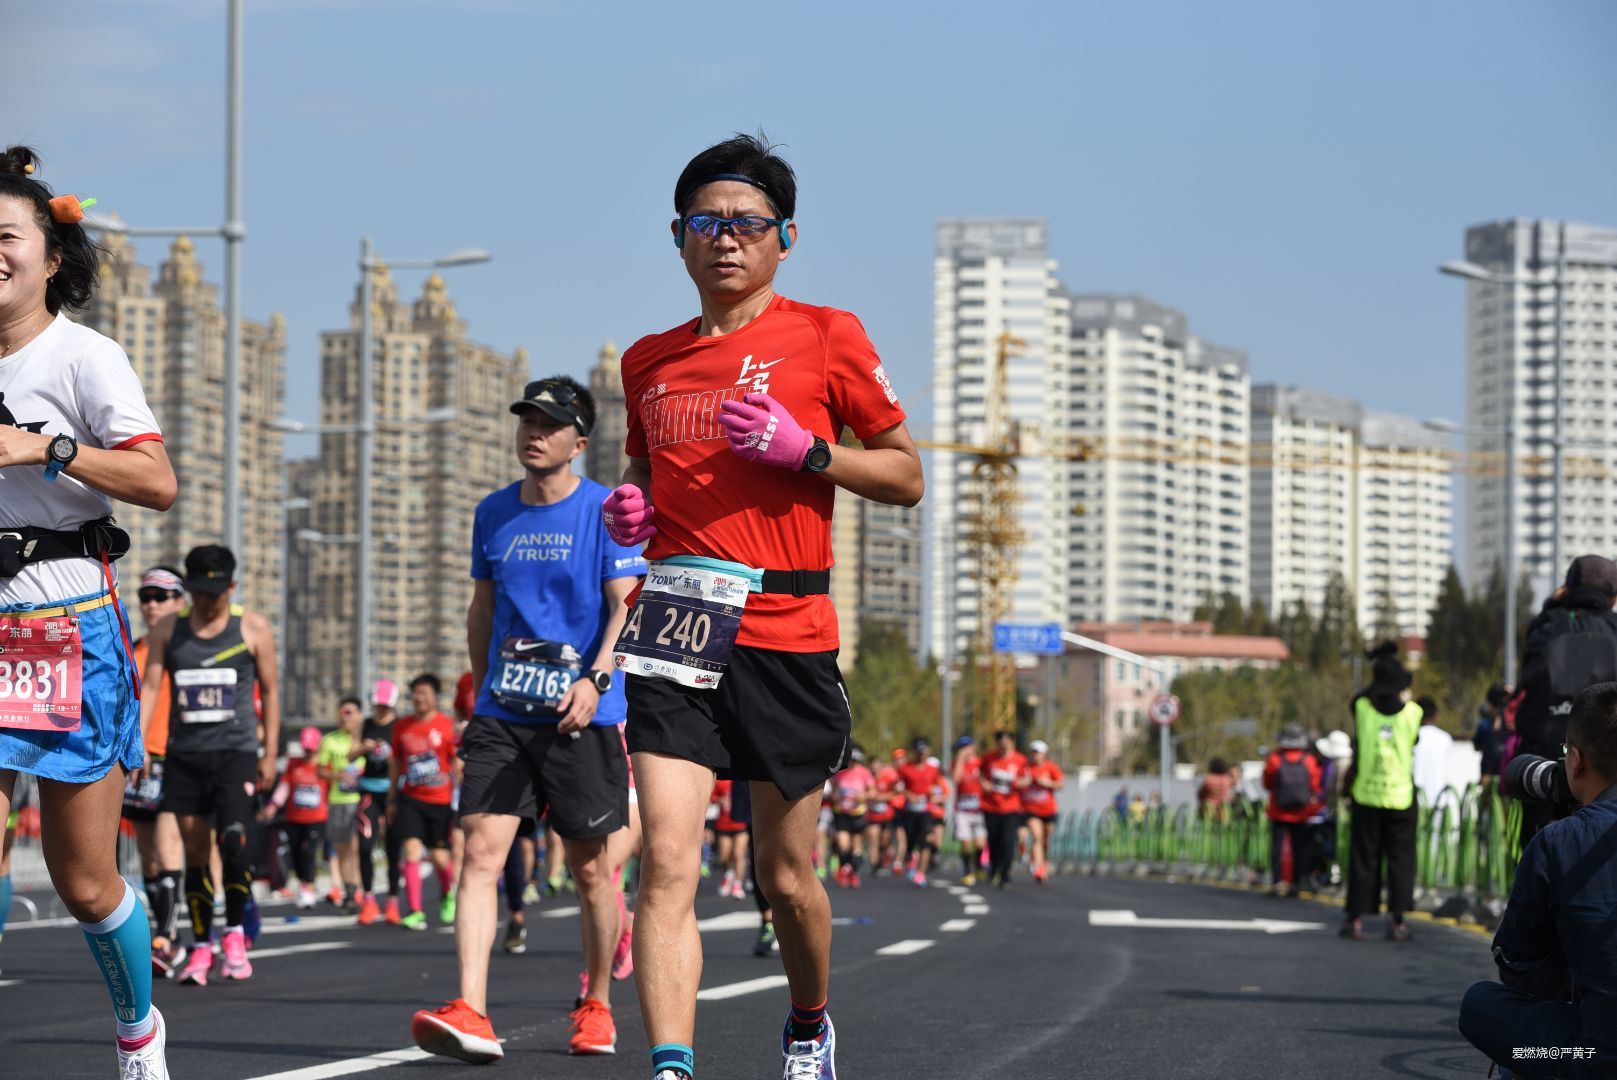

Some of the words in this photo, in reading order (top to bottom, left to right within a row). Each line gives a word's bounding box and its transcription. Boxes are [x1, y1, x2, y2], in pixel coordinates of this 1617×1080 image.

[757, 415, 779, 452] BEST
[517, 533, 573, 546] ANXIN
[516, 548, 571, 561] TRUST
[684, 577, 701, 590] 东丽
[9, 627, 33, 638] 东丽
[622, 603, 644, 641] A
[655, 607, 711, 653] 240
[500, 662, 572, 700] E27163
[178, 687, 189, 706] A
